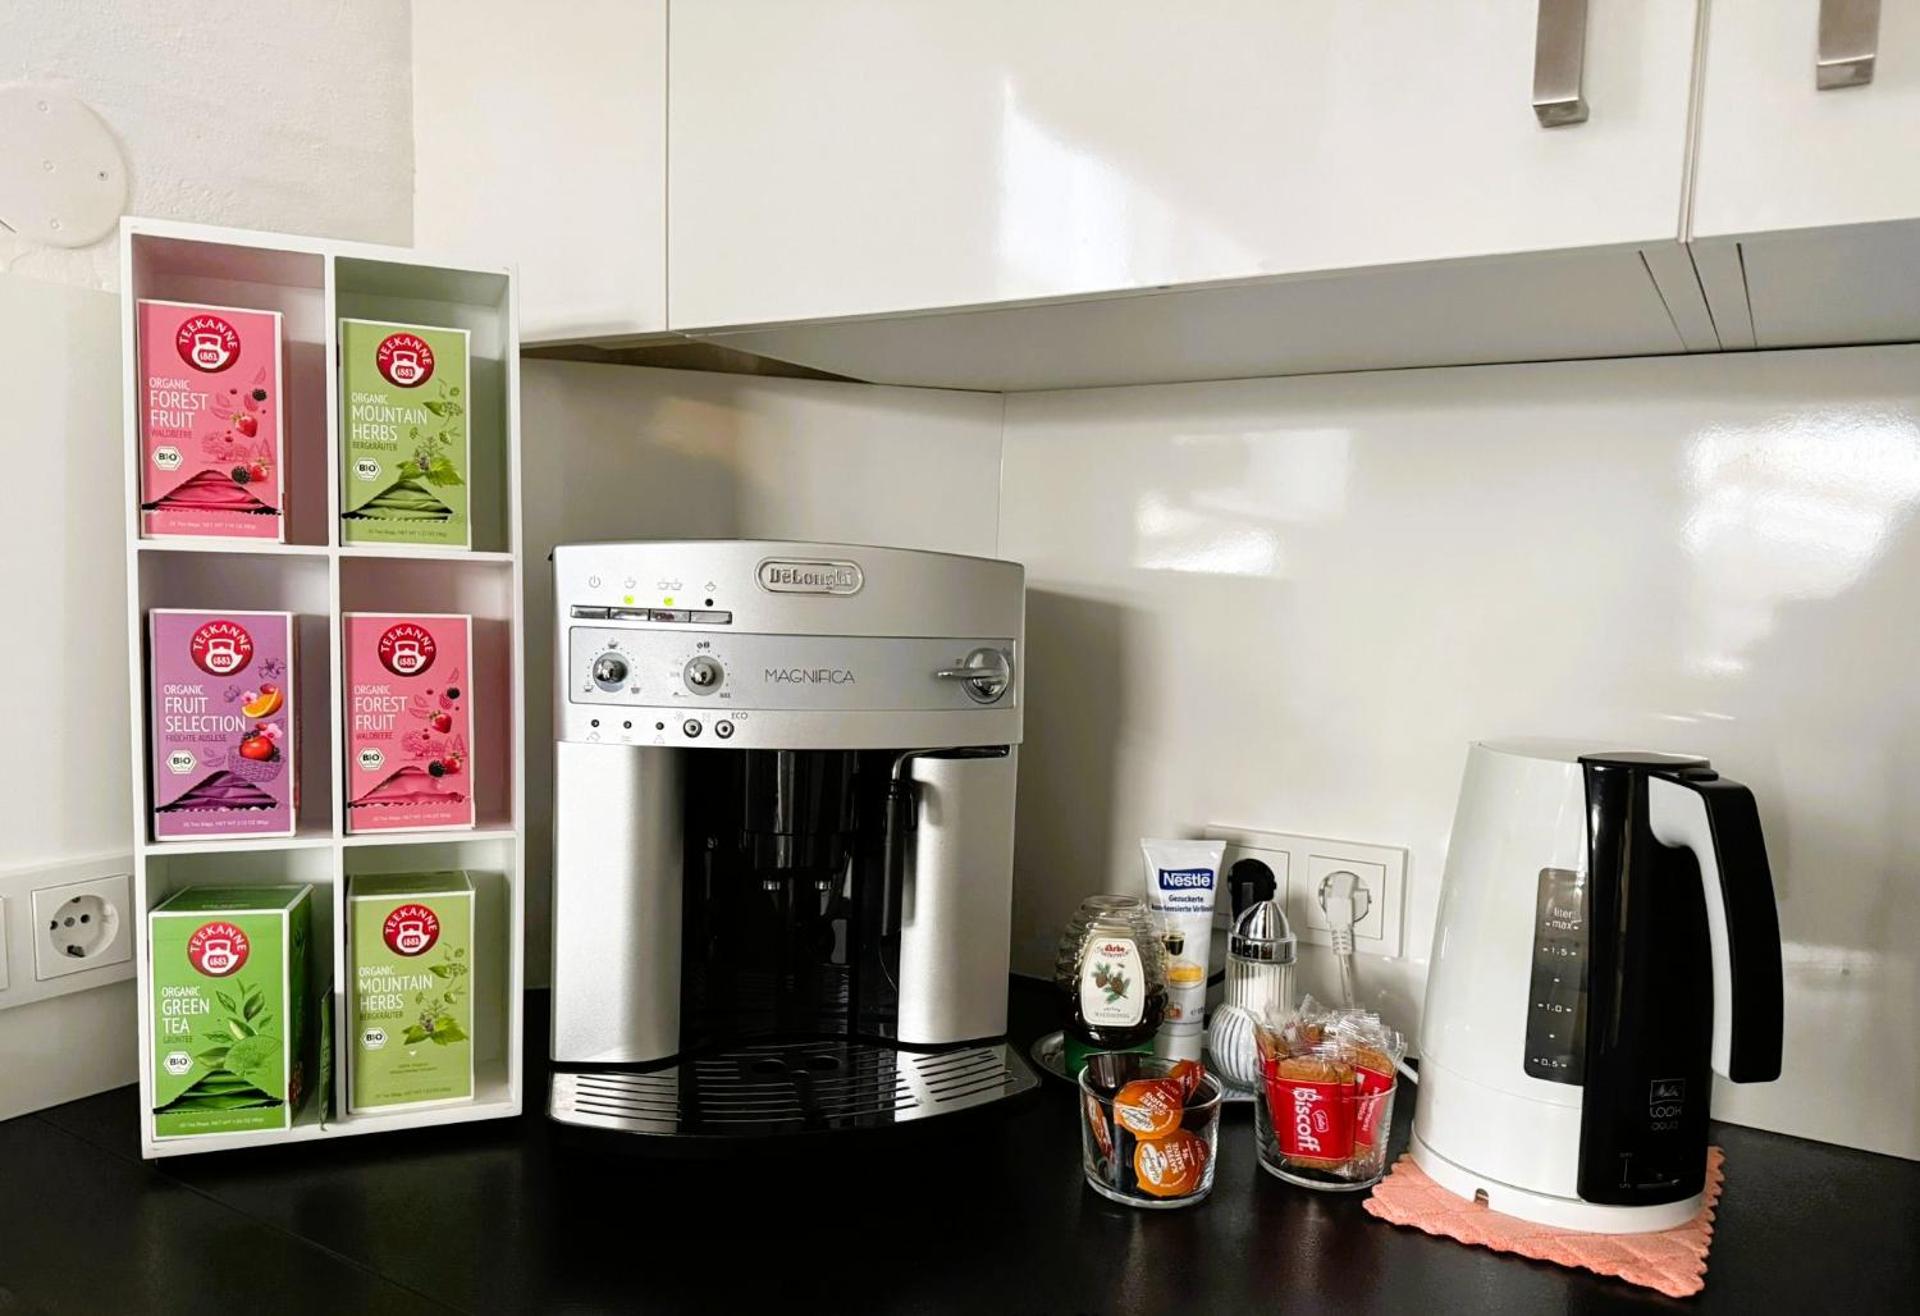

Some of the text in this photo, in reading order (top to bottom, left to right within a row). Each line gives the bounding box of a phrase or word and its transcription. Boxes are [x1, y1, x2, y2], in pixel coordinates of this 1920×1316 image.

[178, 319, 238, 349] TEEKANNE
[379, 337, 432, 365] TEEKANNE
[149, 377, 191, 391] ORGANIC
[150, 390, 208, 411] FOREST
[351, 392, 389, 405] ORGANIC
[151, 409, 195, 429] FRUIT
[352, 405, 428, 424] MOUNTAIN
[352, 424, 398, 441] HERBS
[158, 453, 178, 461] BIO
[359, 464, 376, 472] BIO
[193, 624, 251, 652] TEEKANNE
[380, 627, 433, 653] TEEKANNE
[765, 668, 855, 684] MAGNIFICA
[164, 684, 205, 695] ORGANIC
[354, 684, 391, 696] ORGANIC
[165, 697, 208, 714] FRUIT
[355, 696, 408, 713] FOREST
[165, 715, 246, 733] SELECTION
[355, 714, 395, 731] FRUIT
[731, 712, 748, 721] ECO
[173, 757, 191, 765] BIO
[362, 753, 380, 761] BIO
[1163, 872, 1211, 887] Nestlé
[385, 907, 438, 934] TEEKANNE
[1554, 907, 1572, 919] liter
[1552, 920, 1573, 930] max
[190, 924, 247, 953] TEEKANNE
[359, 966, 395, 978] ORGANIC
[162, 986, 200, 997] ORGANIC
[359, 975, 433, 993] MOUNTAIN
[162, 997, 210, 1015] GREEN
[360, 994, 404, 1011] HERBS
[163, 1017, 190, 1034] TEA
[366, 1033, 383, 1041] BIO
[170, 1058, 188, 1066] BIO
[1292, 1087, 1322, 1152] Biscoff
